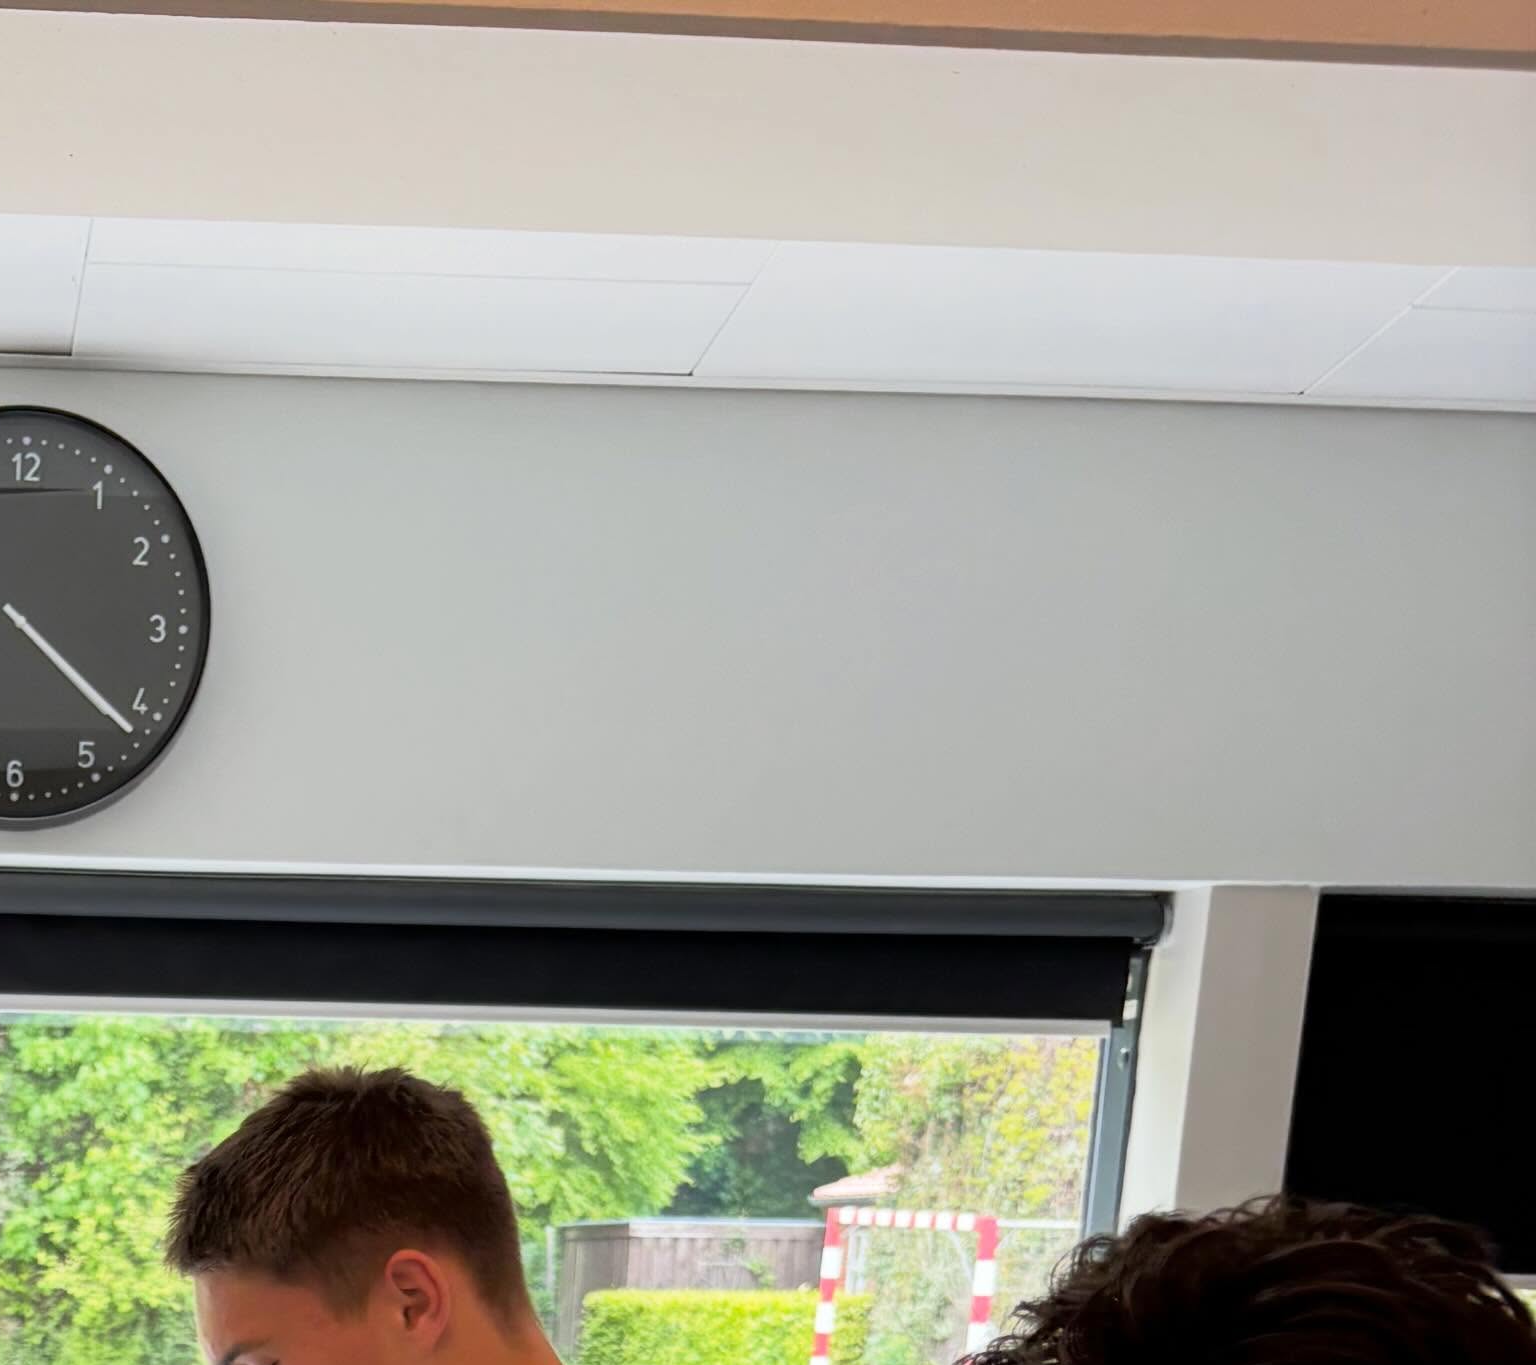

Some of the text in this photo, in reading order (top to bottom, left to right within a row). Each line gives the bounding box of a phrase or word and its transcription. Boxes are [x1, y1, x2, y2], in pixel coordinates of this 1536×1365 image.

[11, 452, 41, 482] 12
[92, 480, 104, 510] 1
[132, 536, 150, 566] 2
[149, 614, 167, 643] 3
[131, 687, 149, 715] 4
[77, 741, 96, 769] 5
[6, 760, 25, 788] 6
